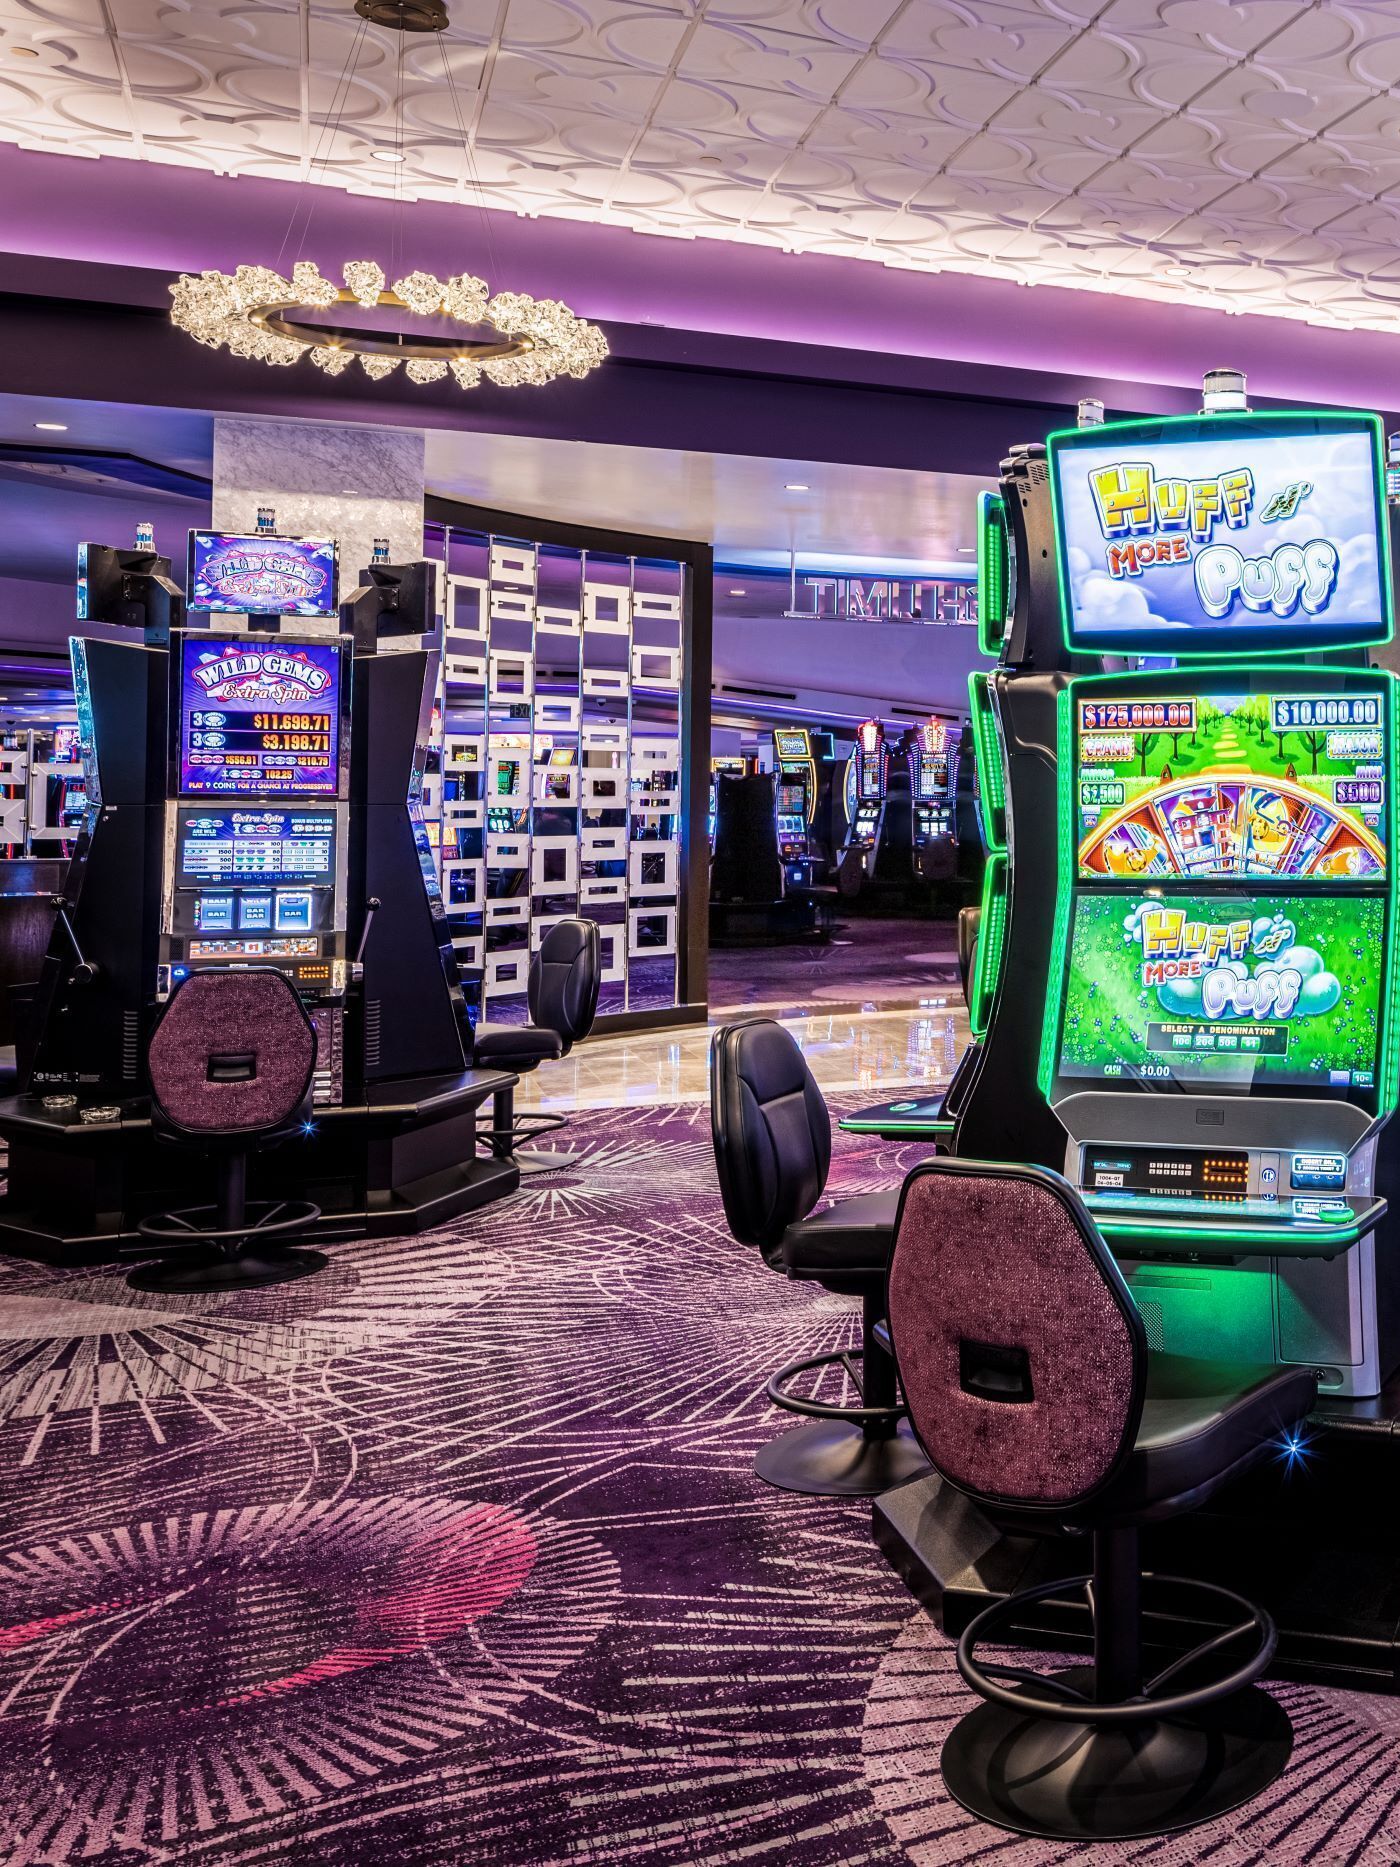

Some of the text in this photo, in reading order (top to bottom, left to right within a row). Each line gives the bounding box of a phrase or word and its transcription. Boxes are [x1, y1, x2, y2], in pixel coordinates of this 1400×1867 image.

[1106, 534, 1190, 578] MORE
[201, 555, 327, 588] WILD GEMS
[220, 579, 316, 598] Extra Spin
[196, 655, 326, 690] WILD GEMS
[223, 683, 309, 703] Extra Spin
[193, 712, 202, 726] 3
[1085, 704, 1190, 728] $125,000.00
[1278, 700, 1376, 725] $10,000.00
[254, 714, 329, 730] $11,698.71
[192, 732, 202, 746] 3
[263, 734, 329, 750] $3,198.71
[1333, 736, 1378, 754] MAJOR
[1085, 740, 1130, 757] GRAND
[1356, 766, 1382, 779] MINI
[1083, 784, 1123, 804] $2,500
[1337, 782, 1380, 802] $500
[232, 813, 285, 824] Extra Spin
[248, 943, 259, 951] $1
[1142, 960, 1202, 986] MORE
[1161, 1025, 1194, 1033] SELECT
[1210, 1026, 1275, 1035] DENOMINATION
[1104, 1065, 1170, 1077] CASH $0.00
